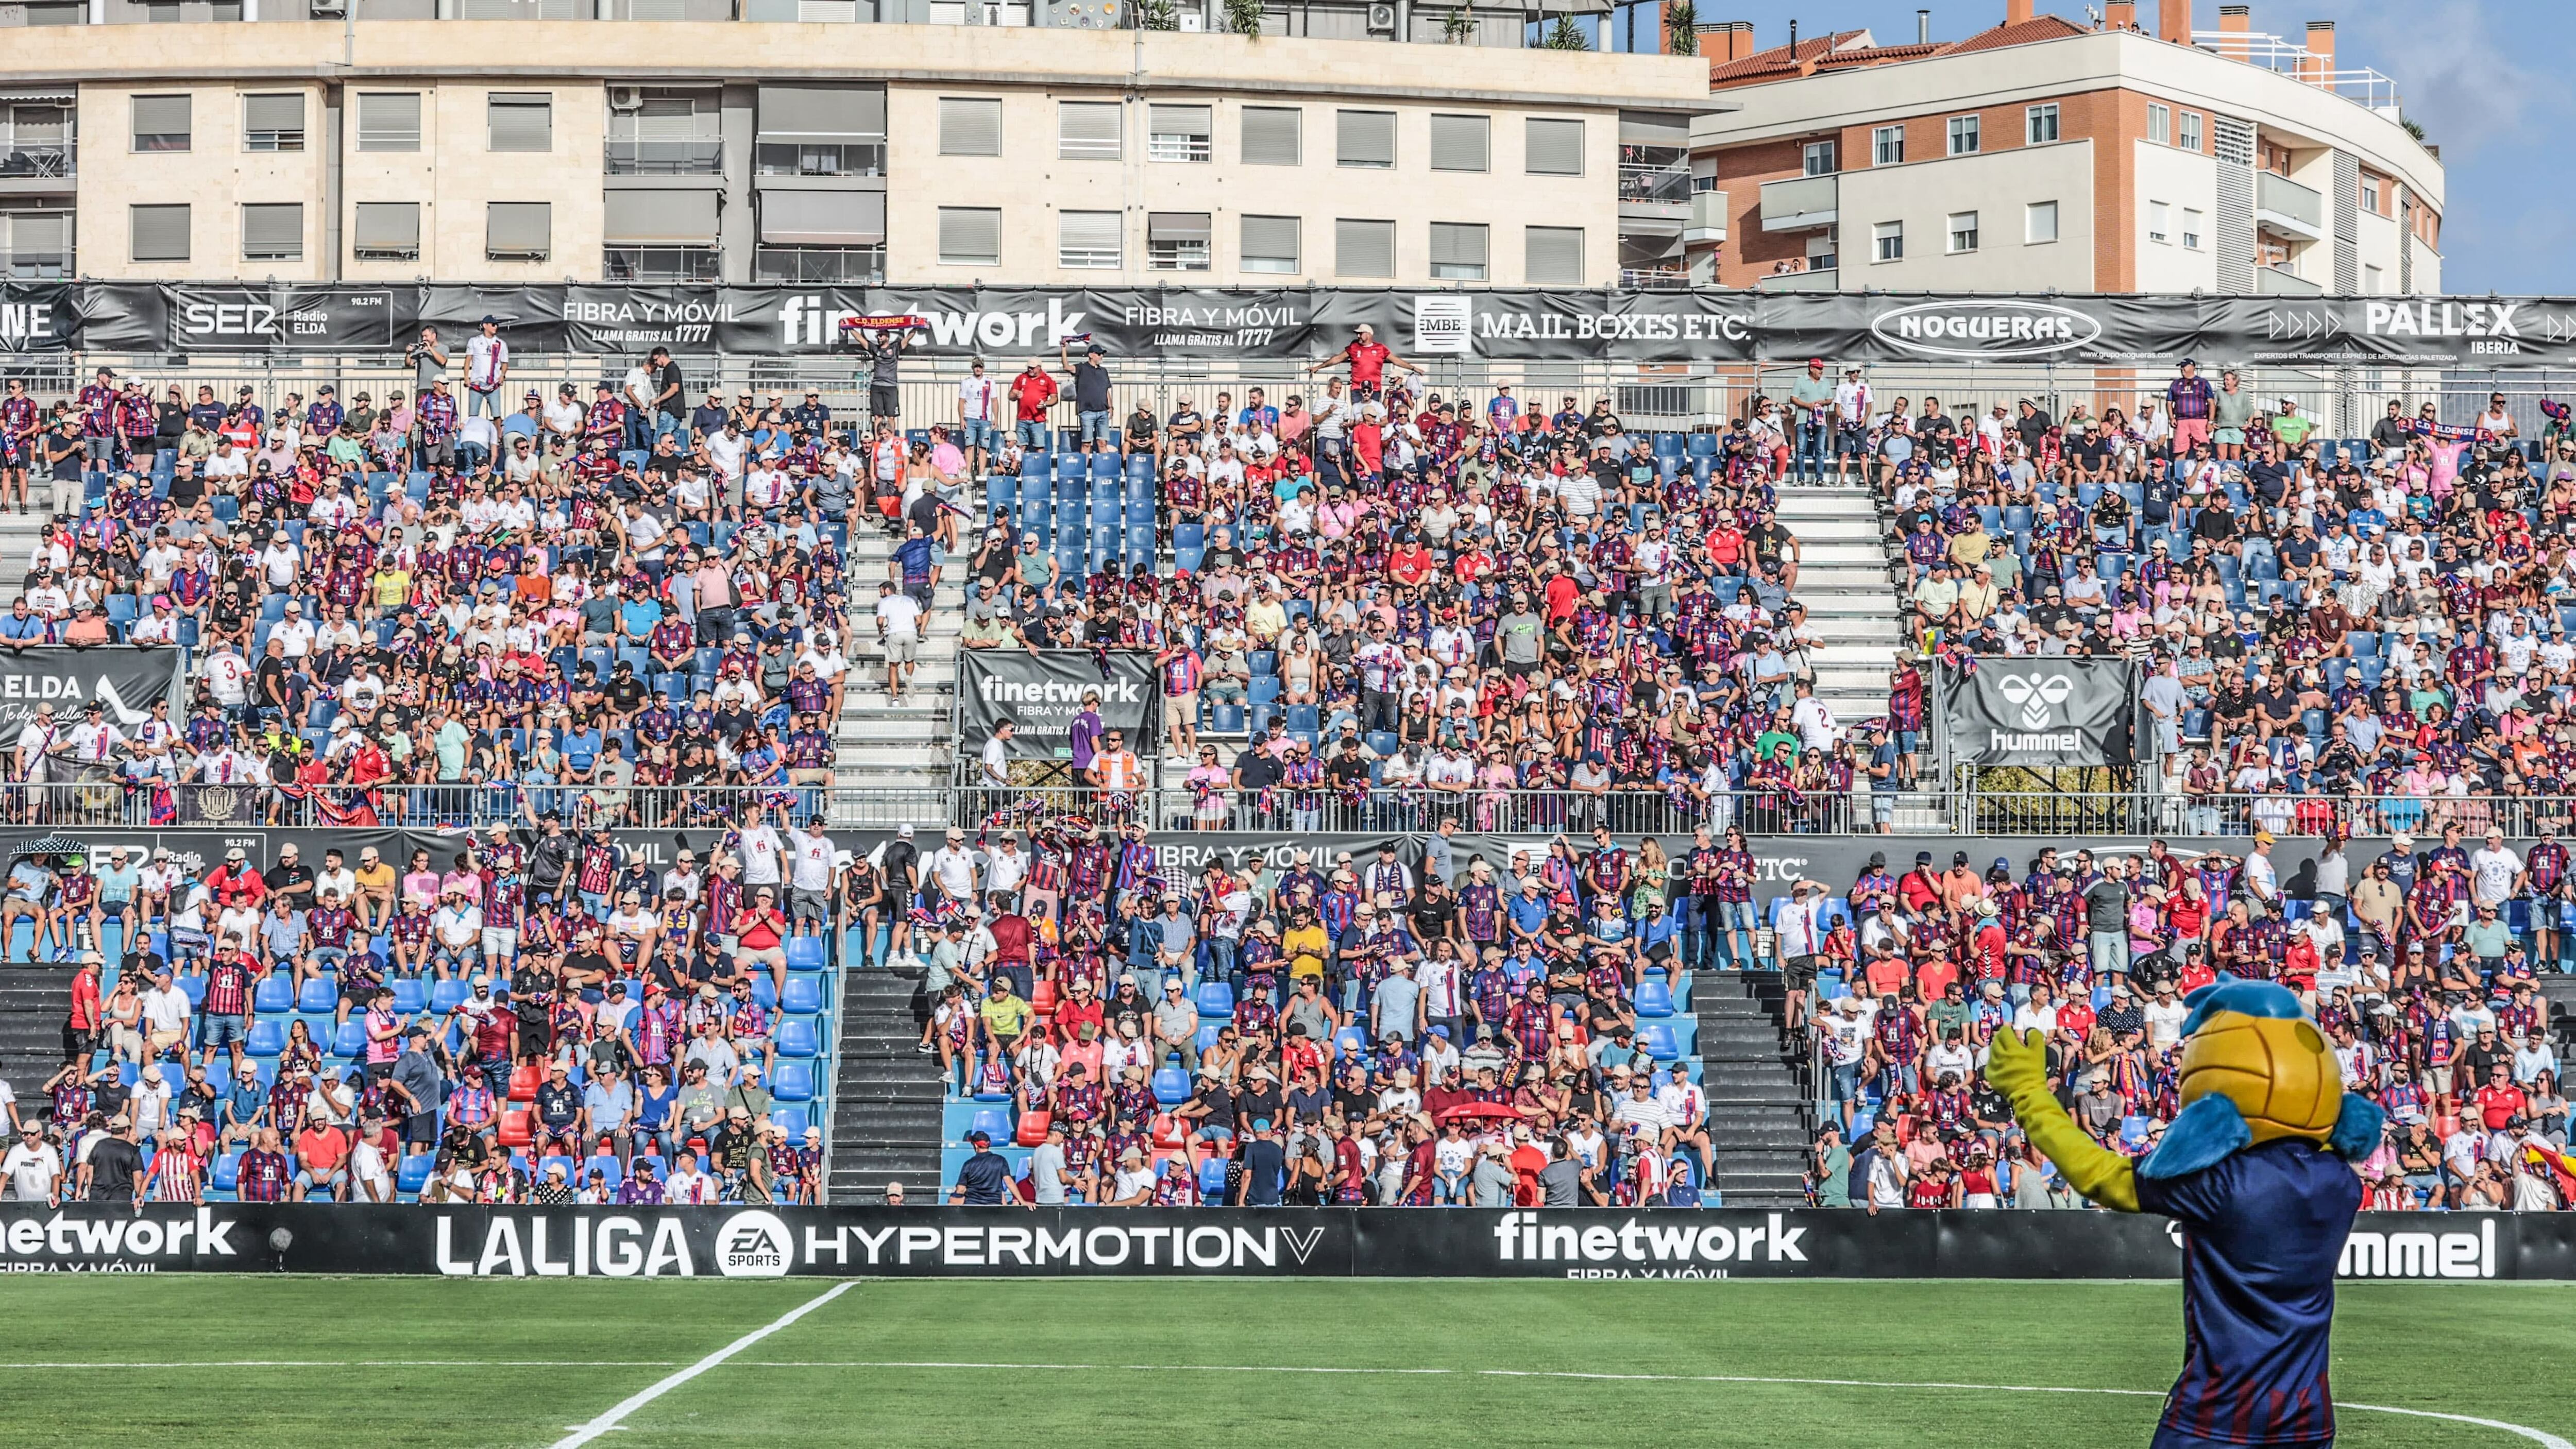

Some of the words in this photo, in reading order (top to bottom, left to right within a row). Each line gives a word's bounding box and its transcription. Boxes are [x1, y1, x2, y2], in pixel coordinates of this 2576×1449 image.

[351, 297, 369, 306] 90.2
[563, 302, 635, 322] FIBRA
[638, 303, 656, 322] Y
[665, 298, 740, 322] MÓVIL
[185, 304, 277, 334] SER
[294, 311, 328, 322] Radio
[871, 316, 904, 325] ELDENSE
[1126, 307, 1197, 326] FIBRA
[1201, 308, 1218, 326] Y
[1226, 303, 1302, 327] MÓVIL
[2366, 302, 2519, 336] PALLEX
[294, 322, 327, 334] ELDA
[592, 330, 624, 342] LLAMA
[625, 330, 659, 342] GRATIS
[660, 331, 673, 342] AL
[675, 325, 711, 342] 1777
[1424, 320, 1461, 331] MBE
[1480, 312, 1572, 339] MAIL
[1578, 313, 1678, 340] BOXES
[1900, 316, 2073, 341] NOGUERAS
[1154, 335, 1185, 346] LLAMA
[1188, 334, 1222, 346] GRATIS
[1223, 334, 1234, 346] AL
[1236, 329, 1273, 346] 1777
[2079, 350, 2174, 360] www.grupo-nogueras.com
[2471, 342, 2520, 355] IBERIA
[2434, 424, 2475, 436] ELDENSE
[224, 660, 236, 680] 3
[4, 674, 82, 699] ELDA
[17, 703, 38, 727] dej
[1017, 706, 1050, 715] FIBRA
[1055, 706, 1063, 715] Y
[1065, 704, 1102, 716] MÓL
[1037, 725, 1064, 735] GRATIS
[1991, 729, 2081, 751] hummel
[1152, 846, 1217, 867] IBRA
[1226, 846, 1245, 866] Y
[436, 1216, 694, 1276] LALIGA
[730, 1229, 778, 1252] EA
[805, 1226, 1276, 1267] HYPERMOTION
[1494, 1212, 1808, 1262] finetwork
[728, 1255, 781, 1267] SPORTS
